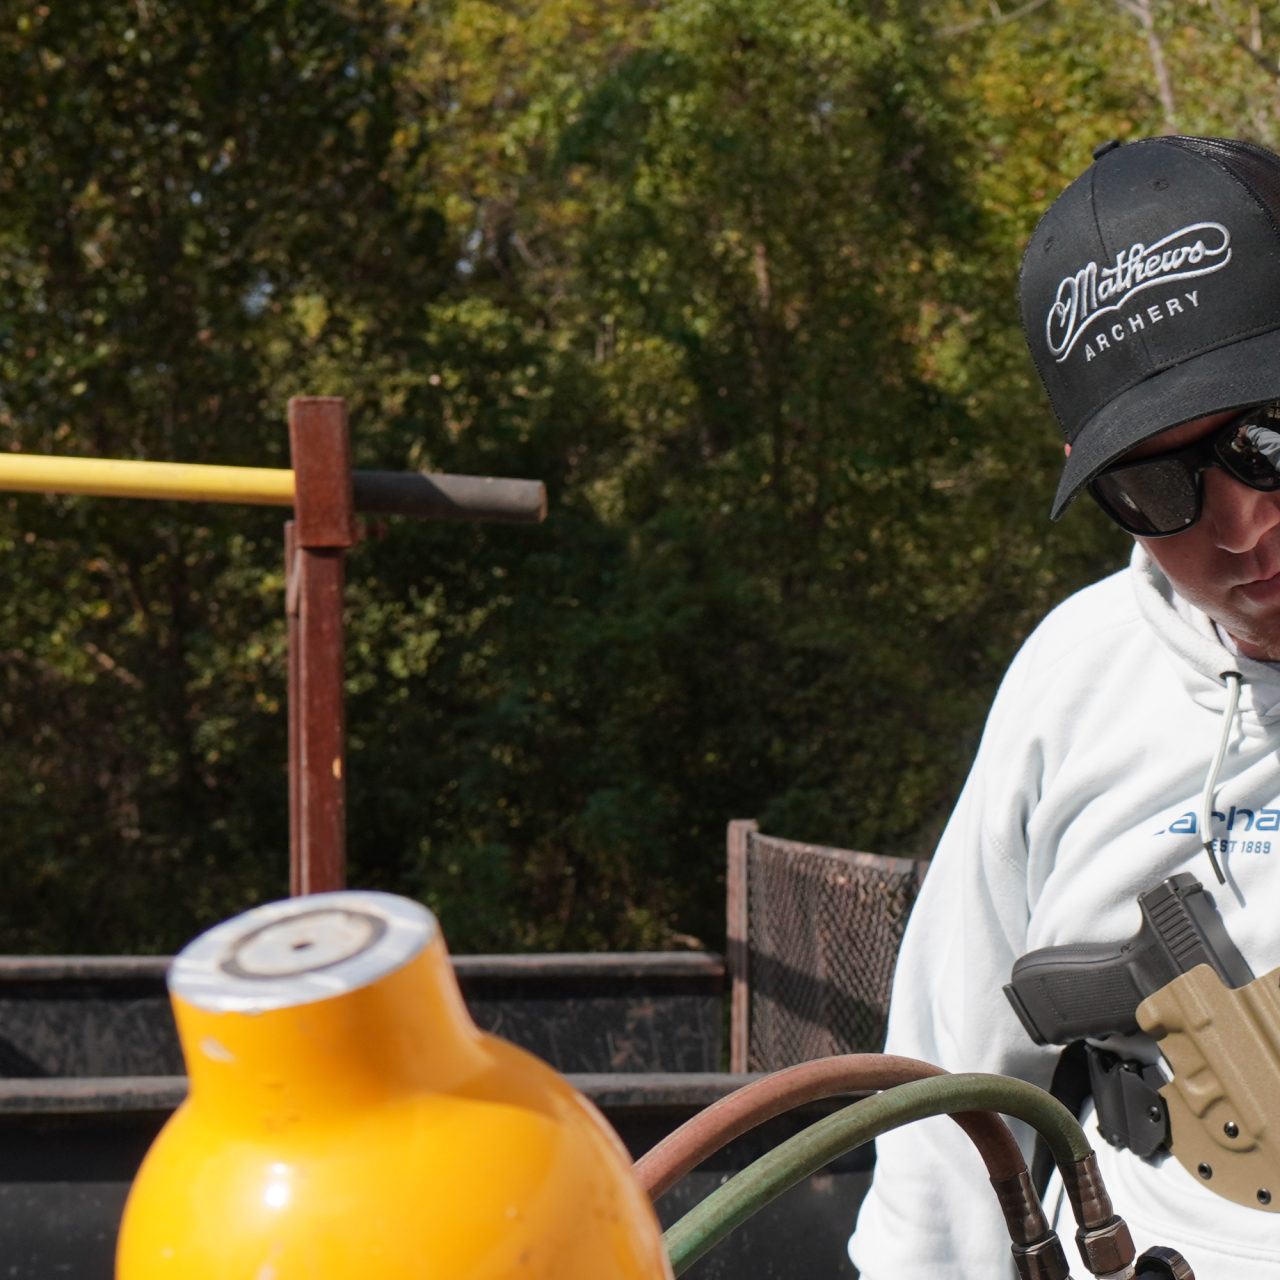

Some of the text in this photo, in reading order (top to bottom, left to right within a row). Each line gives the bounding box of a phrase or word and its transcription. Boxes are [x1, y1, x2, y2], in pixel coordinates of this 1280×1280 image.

[1046, 222, 1230, 360] Mathews
[1084, 290, 1199, 361] ARCHERY
[1241, 840, 1271, 854] 1889
